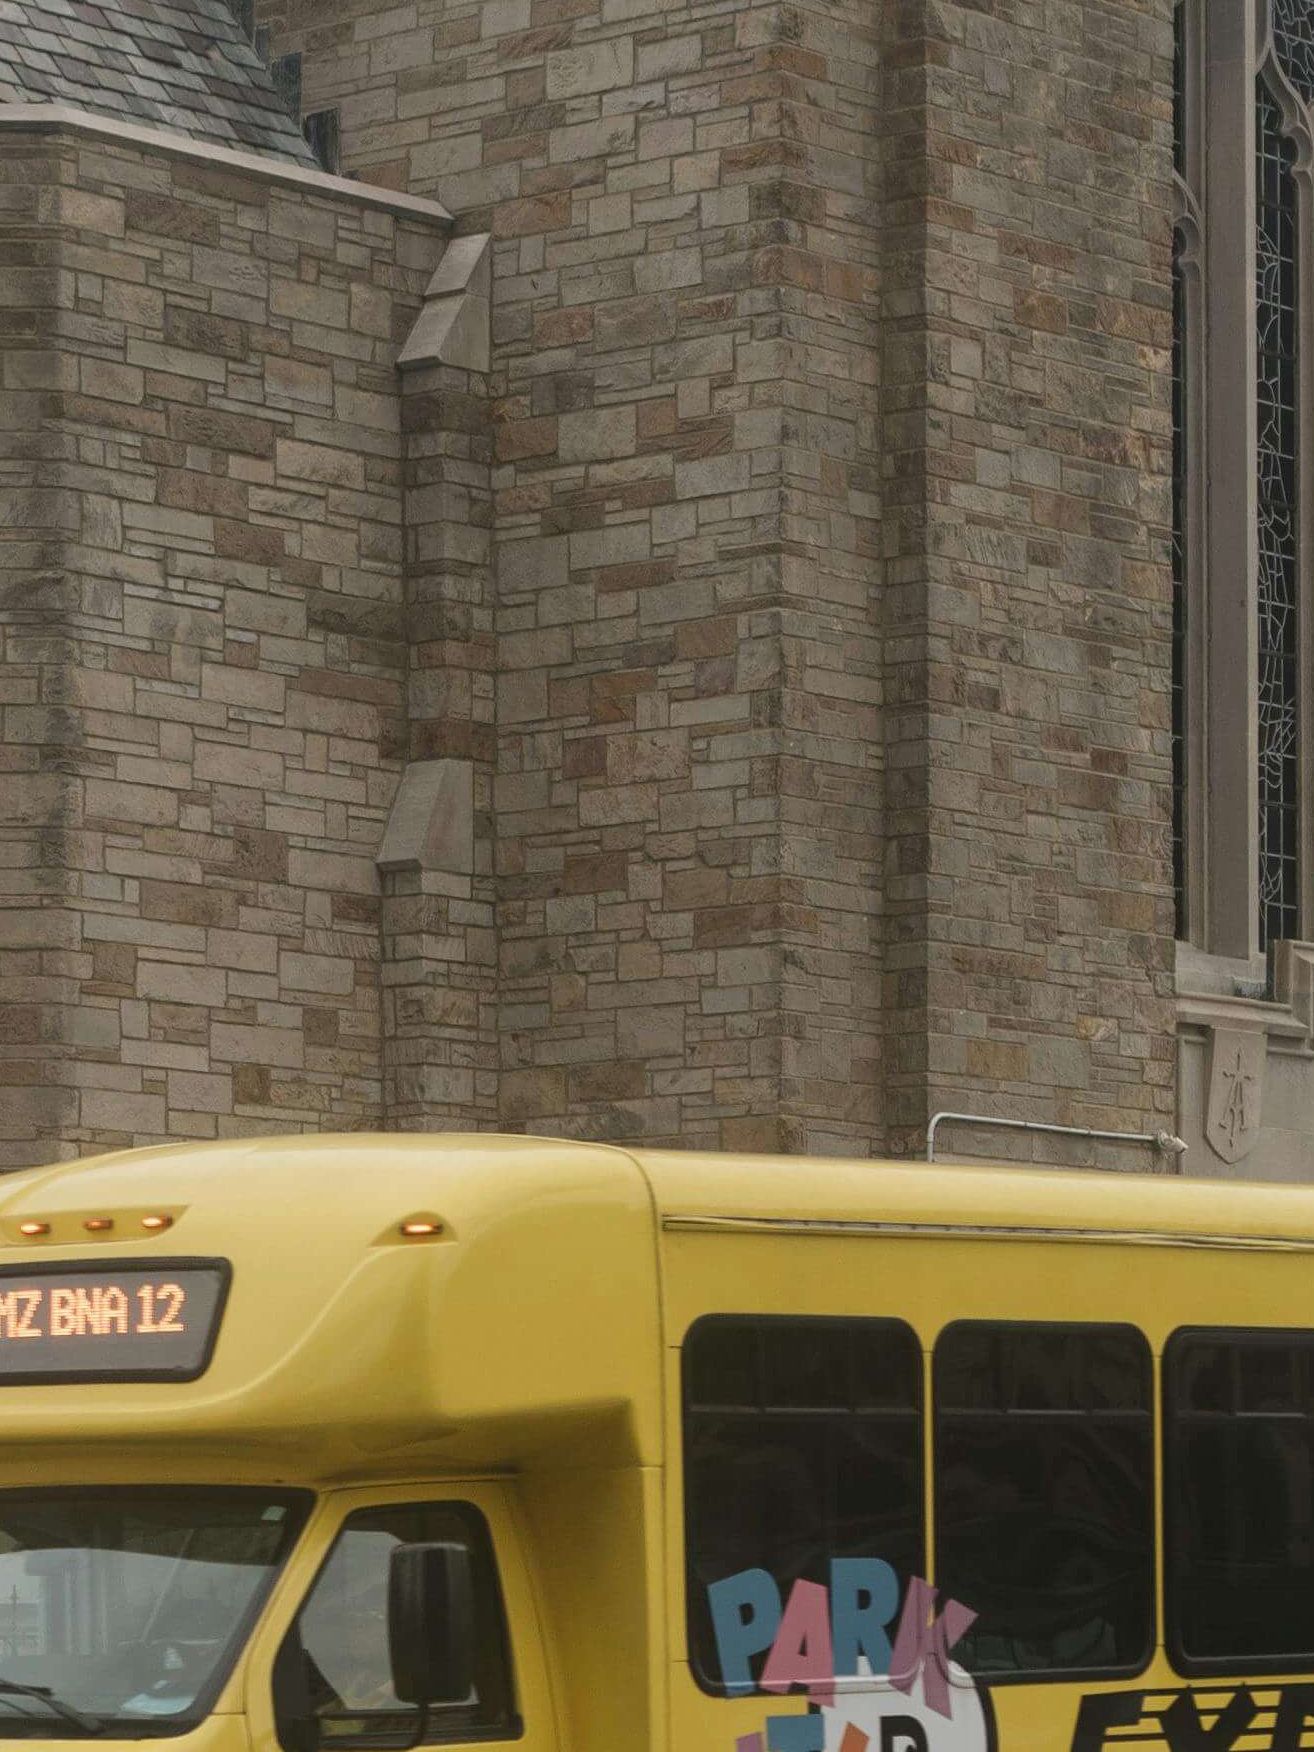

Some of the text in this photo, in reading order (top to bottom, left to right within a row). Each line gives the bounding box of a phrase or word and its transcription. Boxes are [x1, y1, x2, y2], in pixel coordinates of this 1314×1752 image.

[49, 1287, 129, 1338] BNA
[136, 1283, 186, 1334] 12
[707, 1557, 979, 1721] PARK
